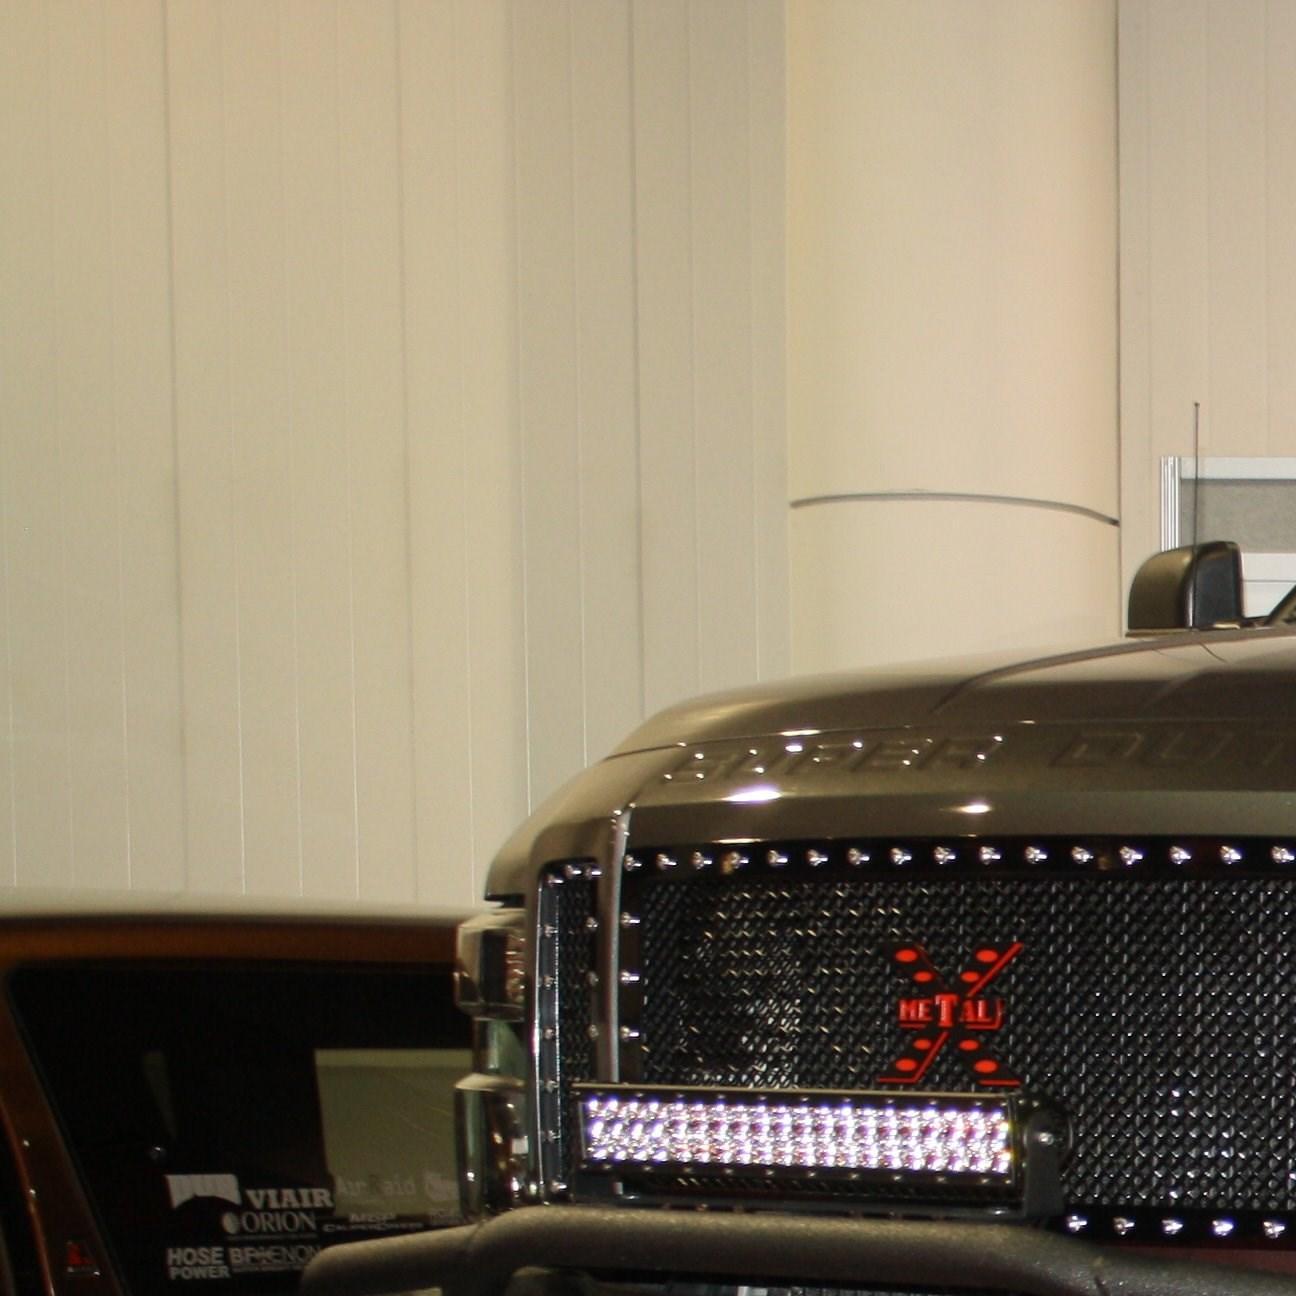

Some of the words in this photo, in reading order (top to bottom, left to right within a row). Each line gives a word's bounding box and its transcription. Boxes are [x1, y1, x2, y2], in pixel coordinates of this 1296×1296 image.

[662, 732, 1004, 786] SUPER
[245, 1188, 333, 1209] VIAIR
[241, 1211, 316, 1233] ORION
[167, 1246, 224, 1266] HOSE
[169, 1265, 231, 1280] POWER
